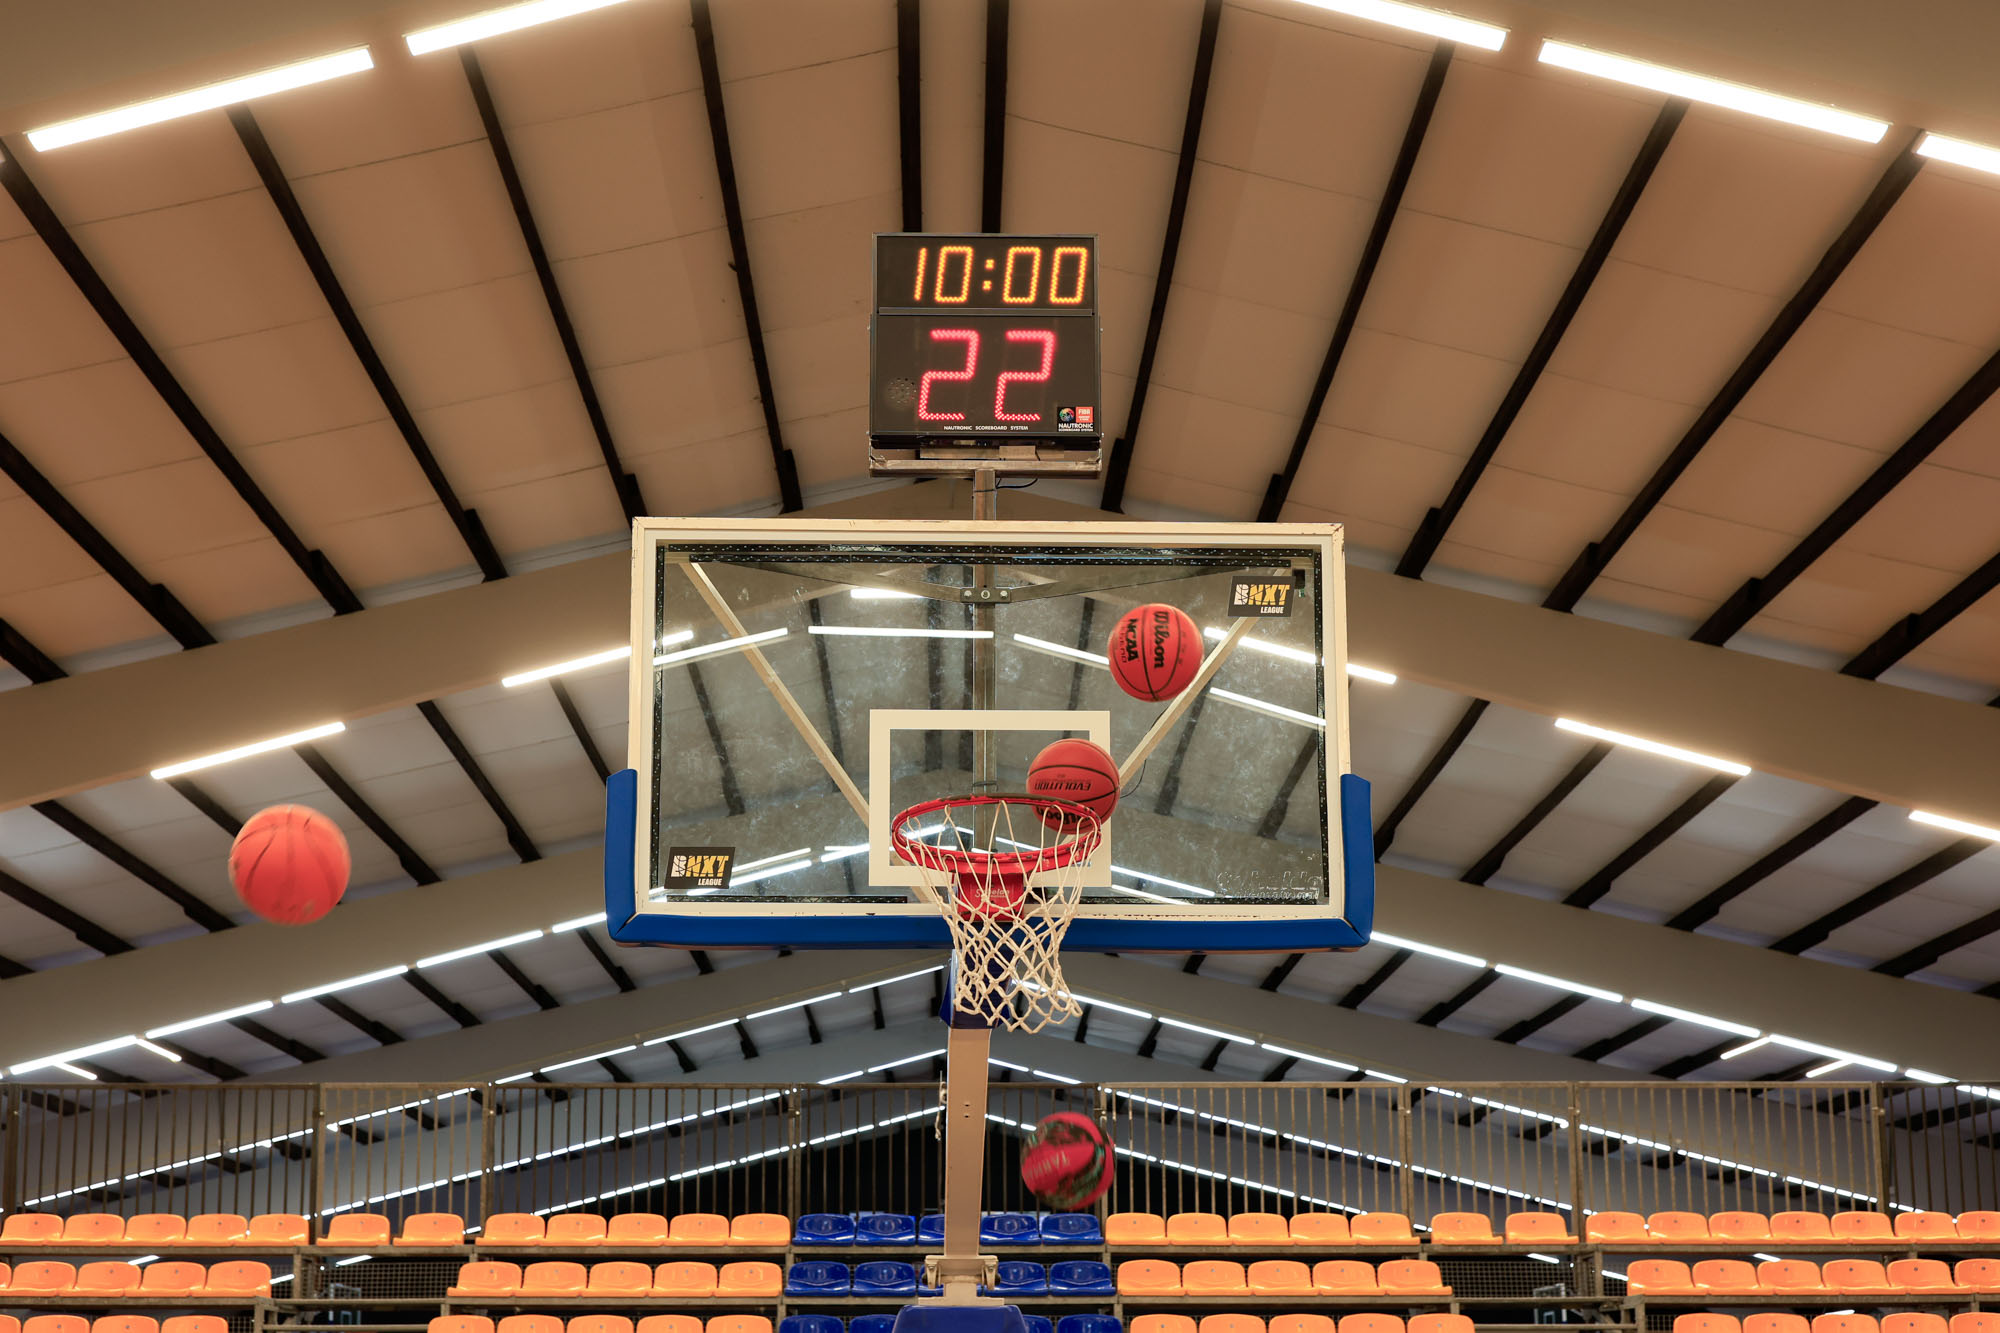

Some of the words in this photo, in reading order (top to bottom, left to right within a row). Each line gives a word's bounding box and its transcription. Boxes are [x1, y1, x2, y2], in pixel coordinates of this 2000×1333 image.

[914, 246, 1088, 304] 10:00
[918, 329, 1056, 420] 22
[1233, 583, 1291, 606] BNXT
[1260, 606, 1285, 614] LEAGUE
[1126, 618, 1139, 662] NCAA
[1154, 611, 1170, 669] Wilson
[671, 855, 730, 878] BNXT
[697, 878, 723, 886] LEAGUE
